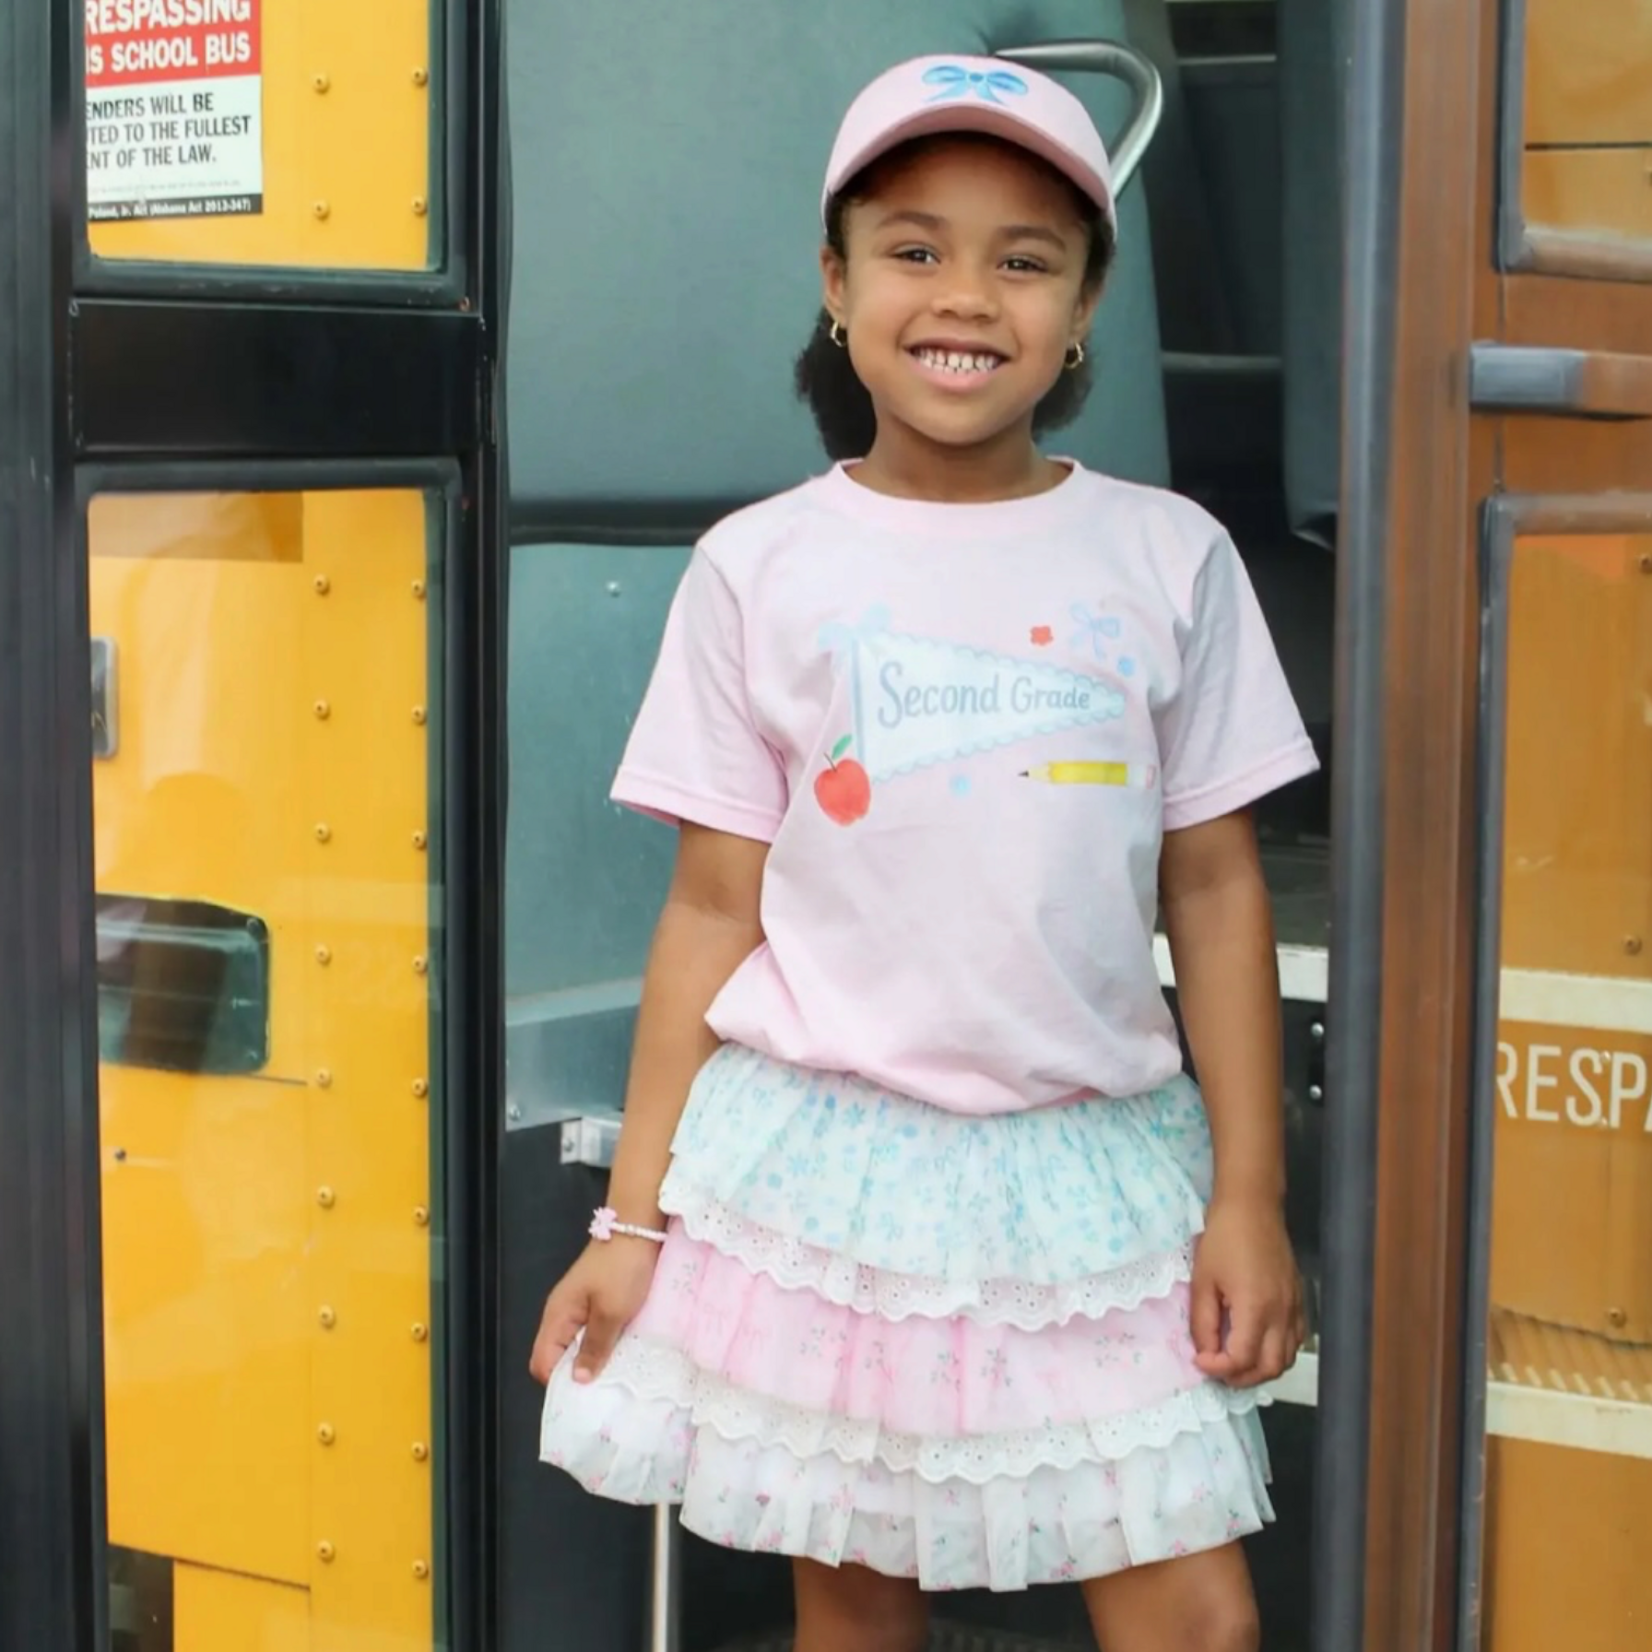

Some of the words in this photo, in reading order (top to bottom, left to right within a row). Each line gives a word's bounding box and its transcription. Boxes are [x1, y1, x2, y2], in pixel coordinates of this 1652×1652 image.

[111, 36, 199, 73] SCHOOL
[205, 31, 251, 65] BUS
[150, 93, 186, 116] WILL
[193, 92, 214, 112] BE
[124, 122, 145, 143] TO
[149, 120, 179, 142] THE
[185, 115, 251, 138] FULLEST
[116, 148, 137, 168] OF
[142, 145, 173, 167] THE
[178, 142, 217, 164] LAW.
[877, 659, 1000, 729] Second
[1010, 675, 1091, 714] Grade
[1497, 1041, 1652, 1132] RESP
